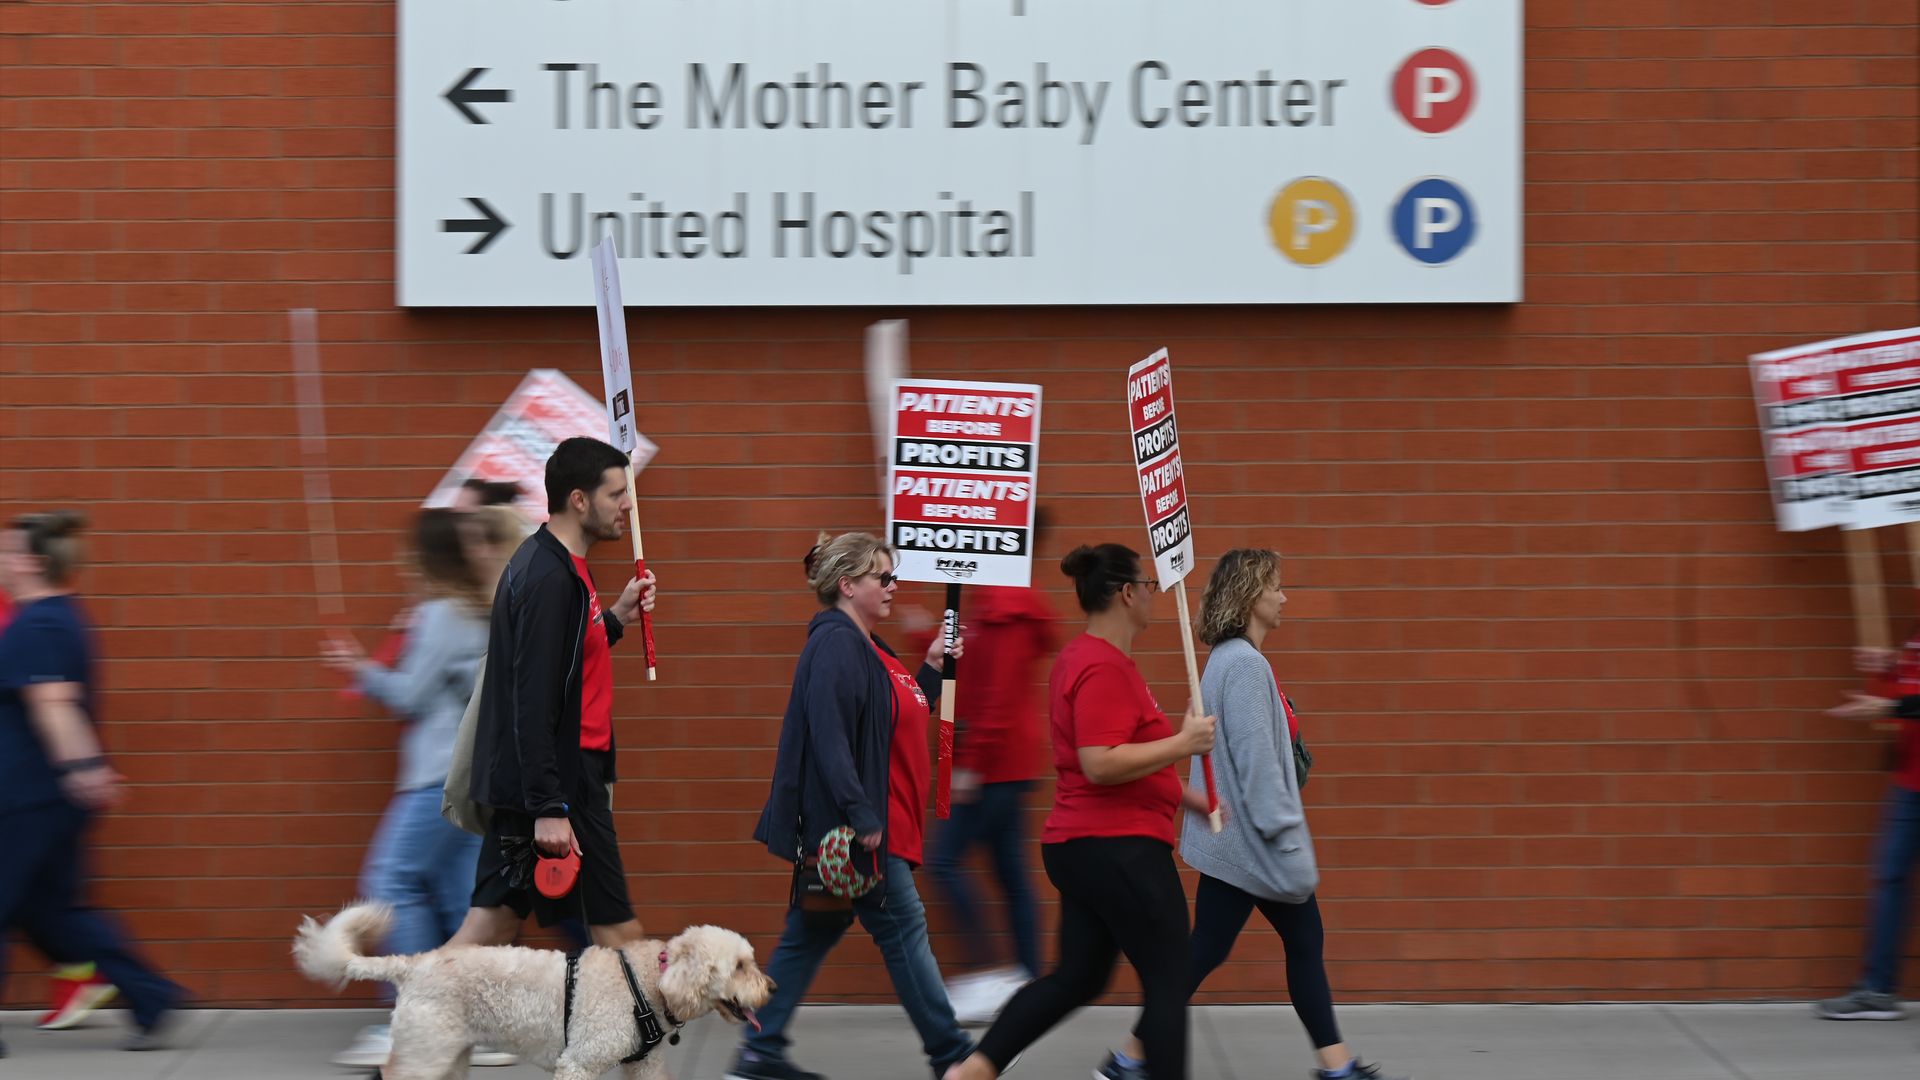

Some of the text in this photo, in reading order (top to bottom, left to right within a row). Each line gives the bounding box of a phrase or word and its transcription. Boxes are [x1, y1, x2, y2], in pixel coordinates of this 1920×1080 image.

[540, 60, 1348, 145] The Mother Baby Center
[1413, 67, 1463, 119] P
[539, 191, 1036, 275] United Hospital
[1291, 197, 1463, 250] P P
[1131, 366, 1170, 403] PATIENTS
[897, 393, 1035, 418] PATIENTS
[1142, 398, 1166, 421] BEFORE
[926, 419, 1002, 436] BEFORE
[1137, 419, 1175, 459] PROFITS
[900, 443, 1026, 469] PROFITS
[894, 476, 1031, 502] PATIENTS
[1141, 457, 1182, 497] PATIENTS
[922, 503, 997, 520] BEFORE
[1156, 491, 1179, 514] BEFORE
[897, 526, 1021, 552] PROFITS
[1152, 511, 1188, 552] PROFITS
